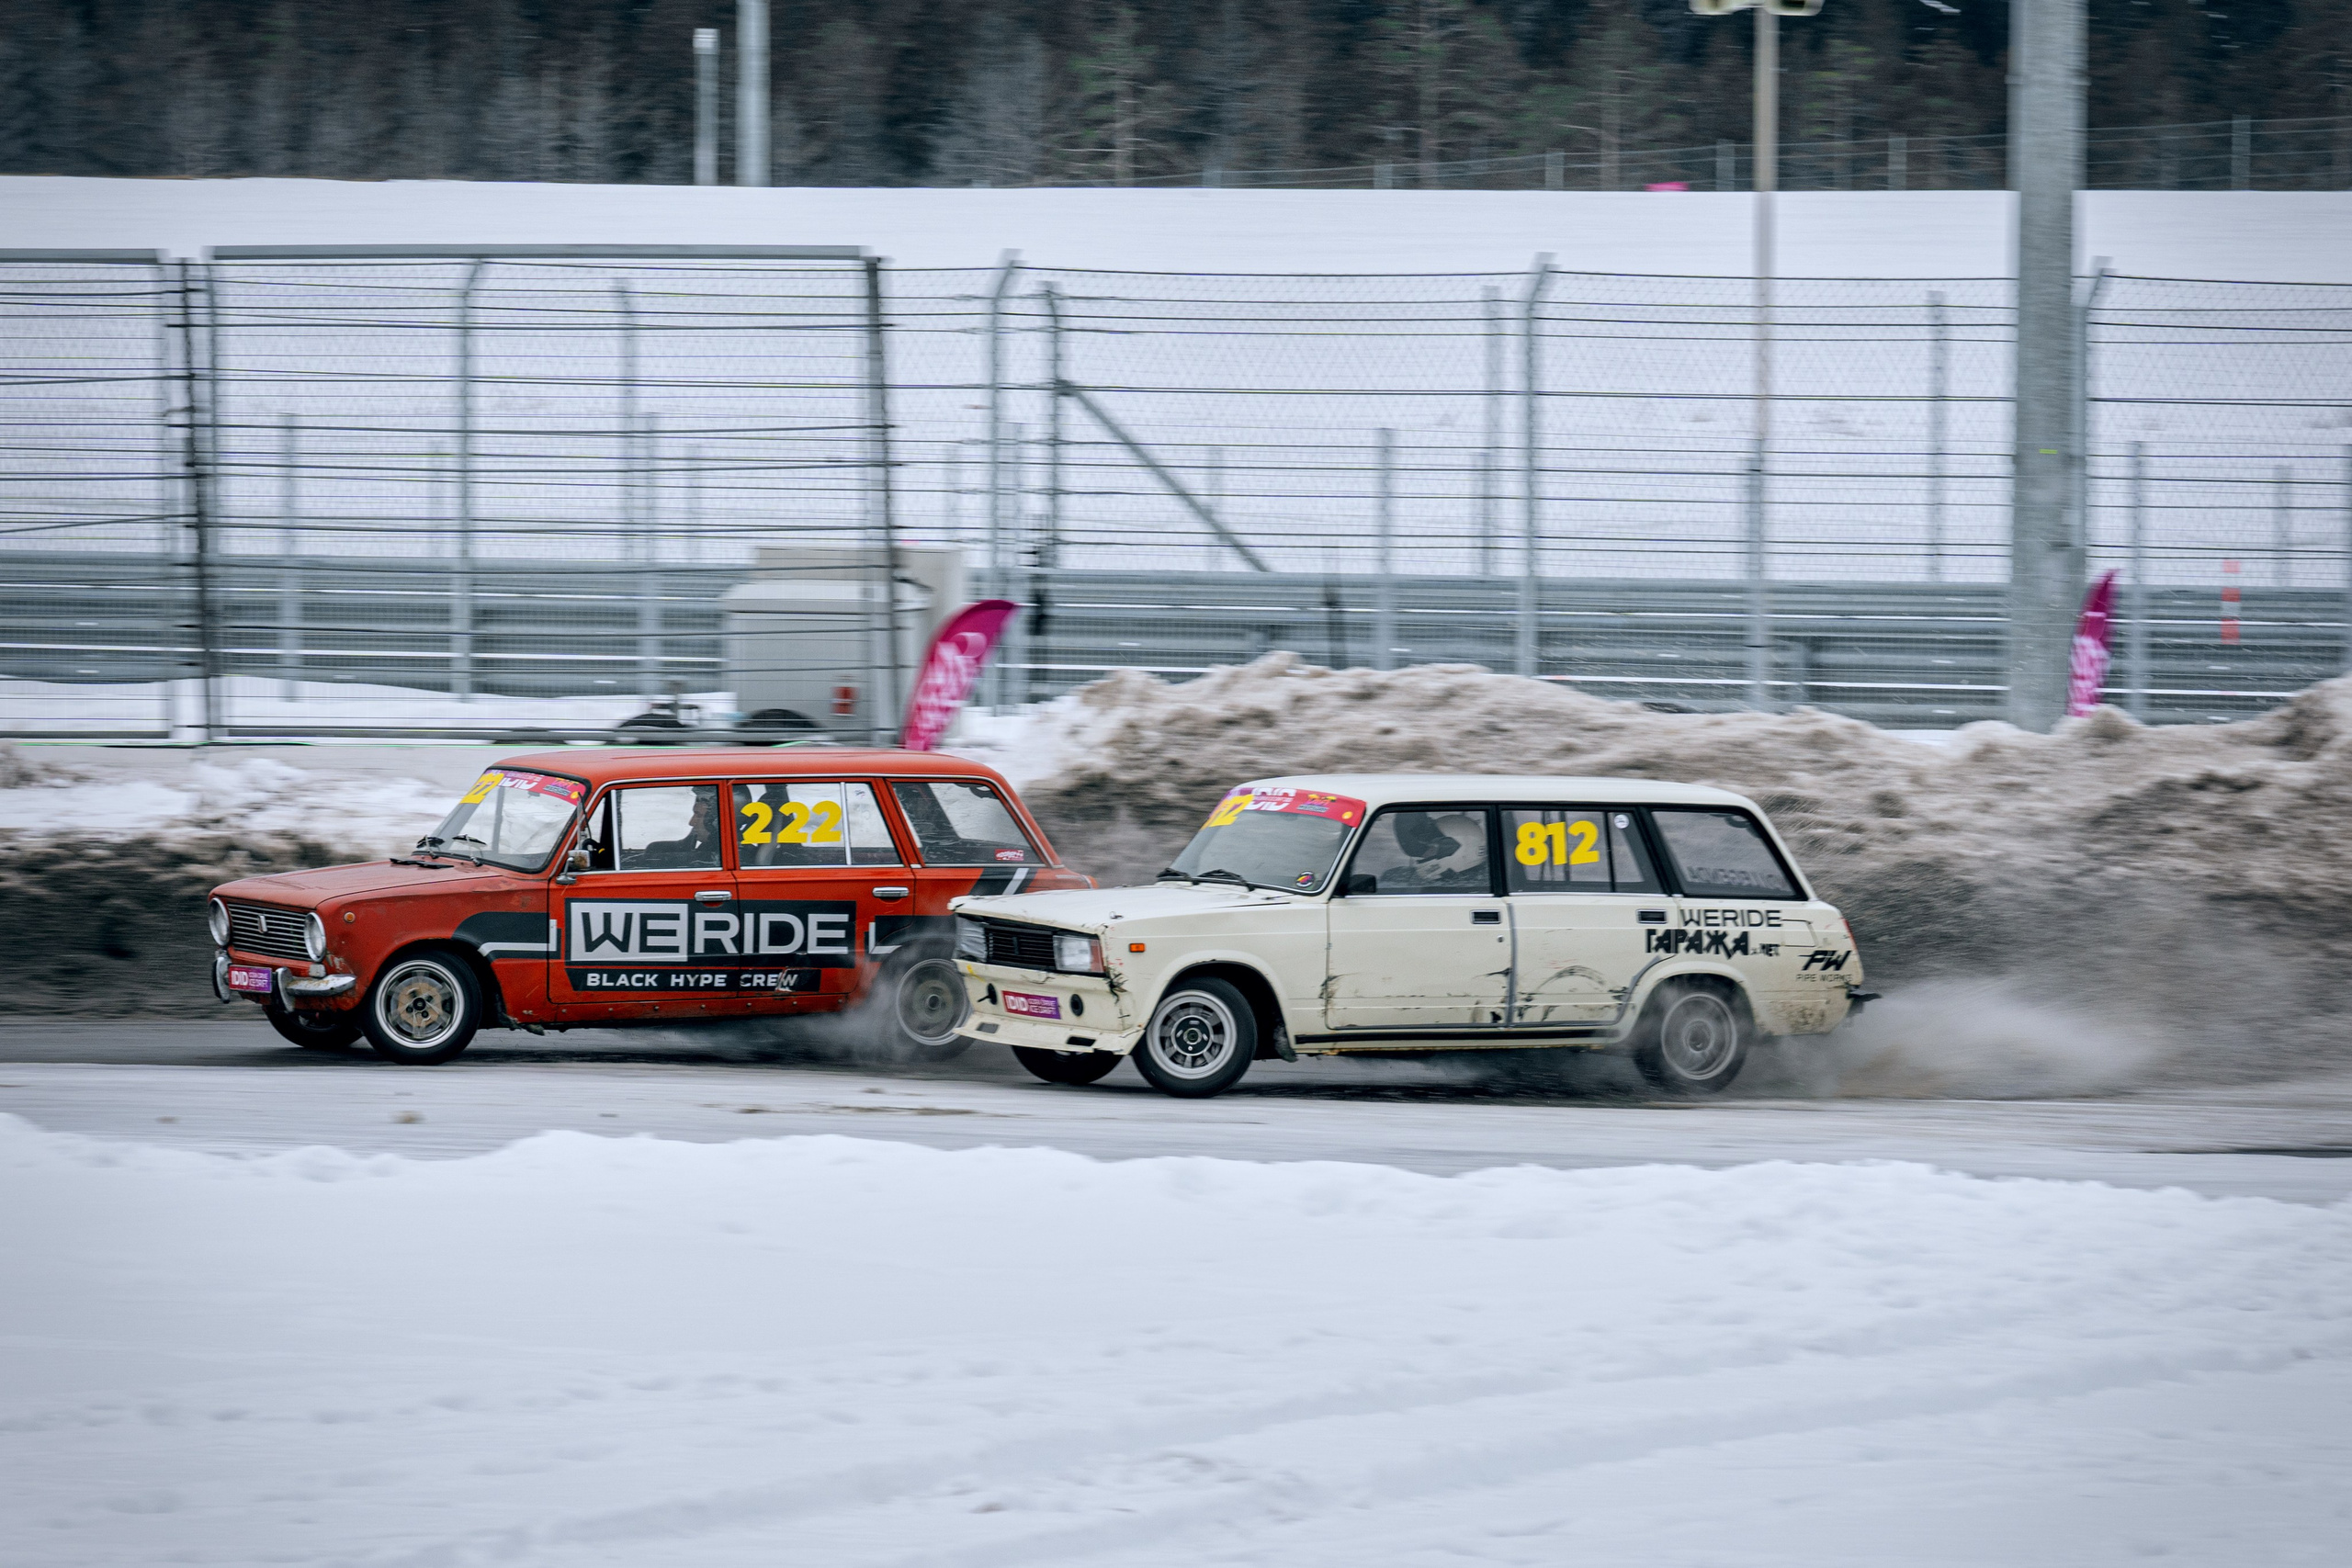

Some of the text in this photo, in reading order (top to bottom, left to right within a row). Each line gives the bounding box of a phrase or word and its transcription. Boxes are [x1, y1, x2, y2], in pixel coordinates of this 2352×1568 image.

[740, 800, 842, 844] 222
[1515, 820, 1600, 865] 812
[579, 910, 850, 954] WERIDE
[1679, 908, 1782, 928] WERIDE
[585, 973, 799, 987] BLACK HYPE CREW
